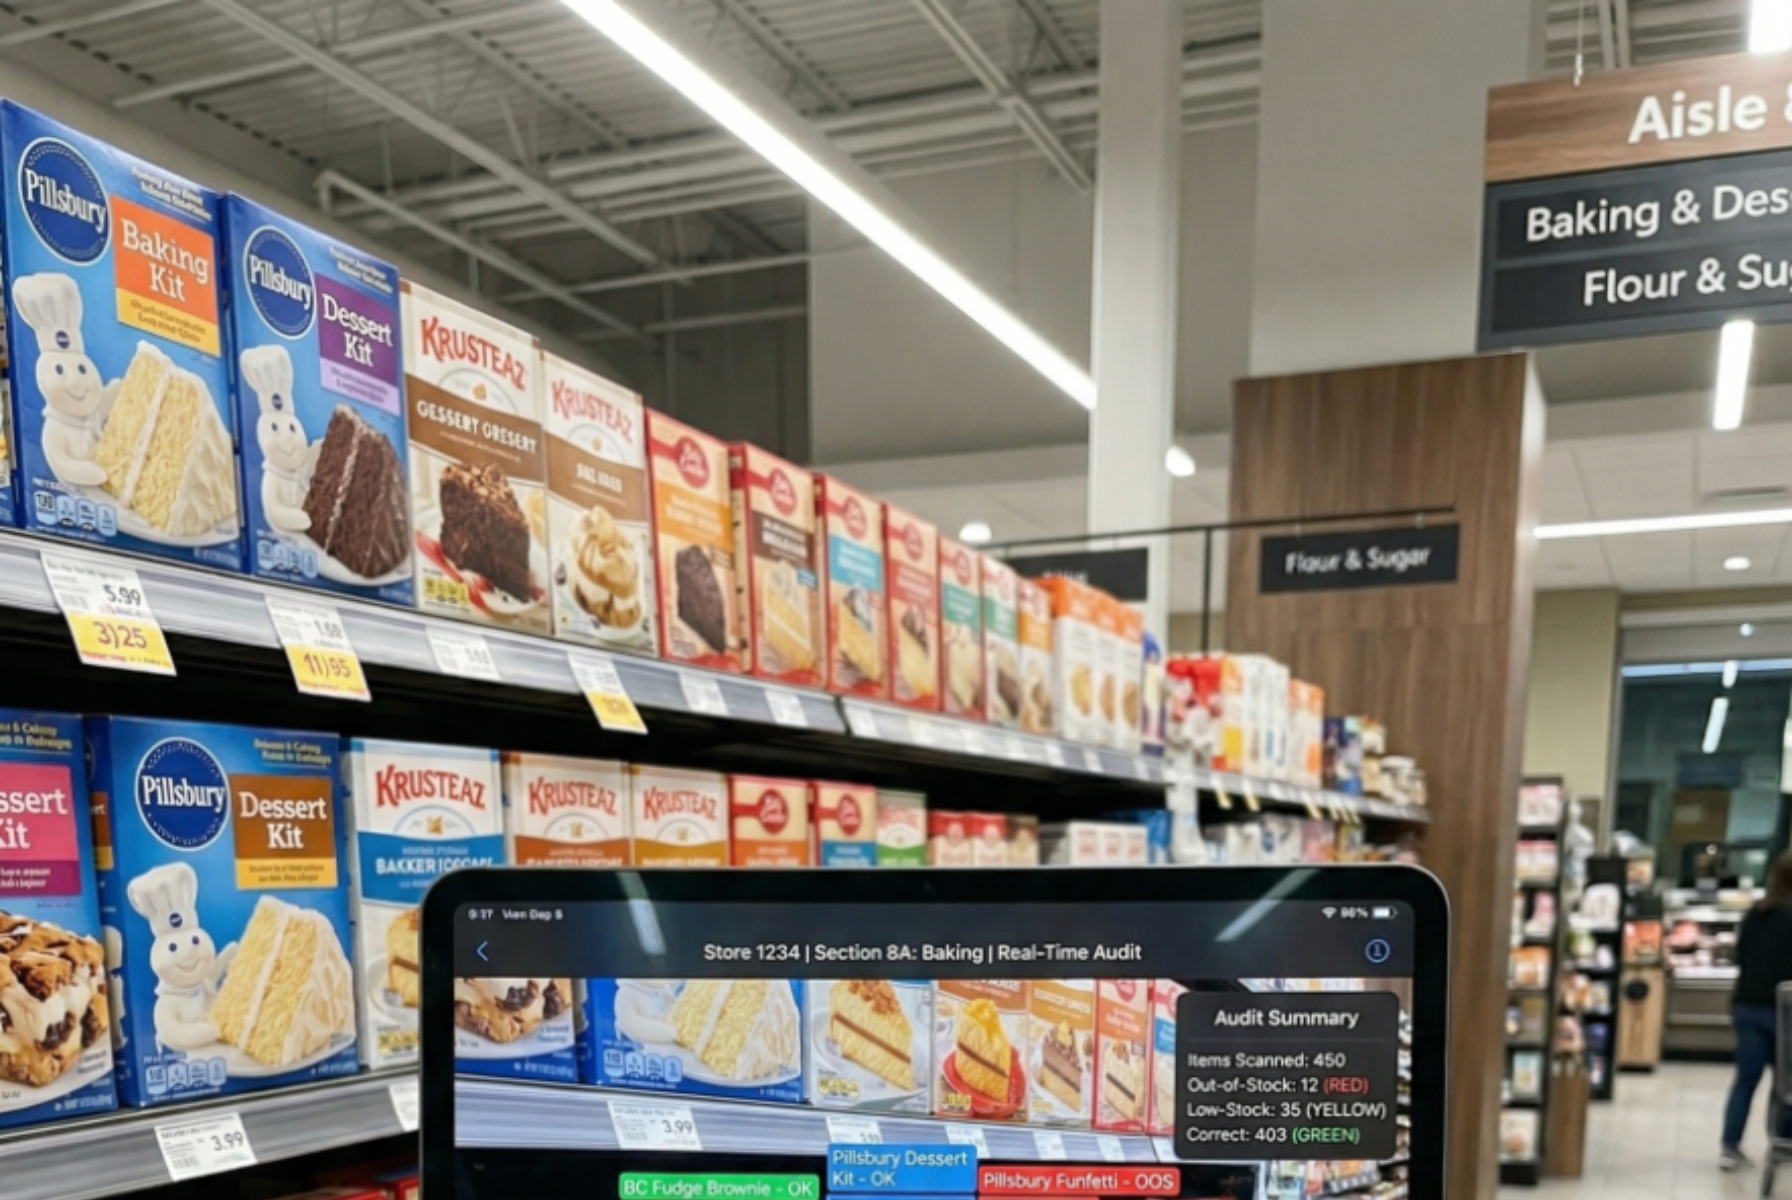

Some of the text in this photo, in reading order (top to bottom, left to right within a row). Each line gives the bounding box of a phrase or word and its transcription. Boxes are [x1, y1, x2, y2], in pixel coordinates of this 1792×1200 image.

[1628, 85, 1768, 144] Aisle
[24, 167, 106, 234] Pillsbury
[1526, 184, 1792, 243] Baking & Des
[120, 218, 209, 285] Baking
[148, 262, 186, 302] Kit
[249, 253, 313, 311] Pillsbury
[1583, 253, 1792, 307] Flour & Su
[321, 292, 393, 348] Dessert
[343, 331, 374, 368] Kit
[420, 315, 526, 392] KRUSTEAZ
[1344, 547, 1363, 571] &
[141, 775, 226, 814] Pillsbury
[375, 764, 487, 811] KRUSTEAZ
[528, 776, 618, 816] KRUSTEAZ
[238, 791, 328, 820] Dessert
[643, 786, 718, 822] KRUSTEAZ
[266, 822, 305, 849] Kit
[704, 943, 752, 961] Store
[756, 943, 801, 960] 1234
[814, 943, 882, 961] Section
[886, 943, 918, 961] 8A:
[922, 943, 983, 965] Baking
[998, 943, 1089, 961] Real-Time
[1093, 943, 1142, 961] Audit
[1214, 1008, 1360, 1030] Audit Summary
[1187, 1053, 1346, 1069] Items Scanned: 450
[1187, 1077, 1369, 1095] Out-of-Stock: 12 (RED)
[1187, 1102, 1387, 1120] Low-Stock: 35 (YELLOW)
[662, 1119, 693, 1134] 3.99
[1186, 1127, 1361, 1145] Correct: 403 (GREEN)
[210, 1131, 244, 1152] 3.99
[832, 1150, 968, 1169] Pillsbury Dessert
[624, 1180, 648, 1196] BC
[653, 1180, 702, 1199] Fudge
[707, 1180, 771, 1196] Brownie
[788, 1180, 812, 1197] OK
[832, 1171, 855, 1187] Kit
[871, 1171, 896, 1187] OK
[984, 1172, 1051, 1191] Pillsbury
[1056, 1172, 1118, 1188] Funfetti
[1135, 1172, 1174, 1189] OOS
